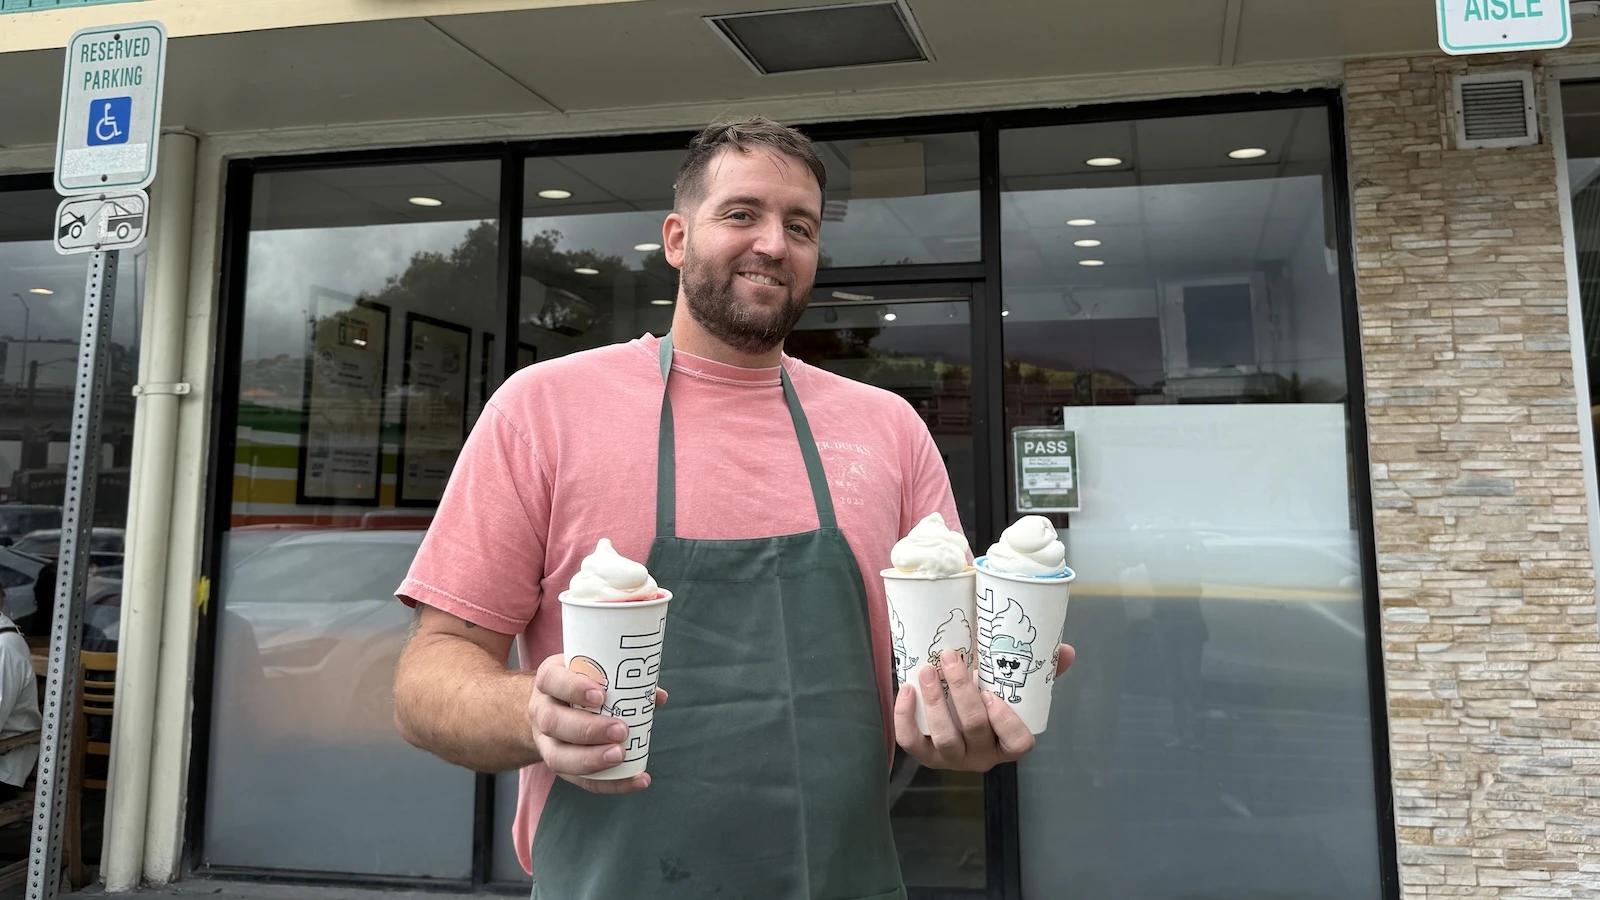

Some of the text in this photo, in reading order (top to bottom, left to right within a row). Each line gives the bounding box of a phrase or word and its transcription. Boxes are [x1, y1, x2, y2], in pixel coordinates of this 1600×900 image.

[1464, 0, 1543, 21] AISLE
[80, 37, 150, 63] RESERVED
[83, 66, 143, 91] PARKING
[834, 441, 871, 456] DUCKS
[1024, 441, 1068, 454] PASS
[611, 617, 665, 762] EARL
